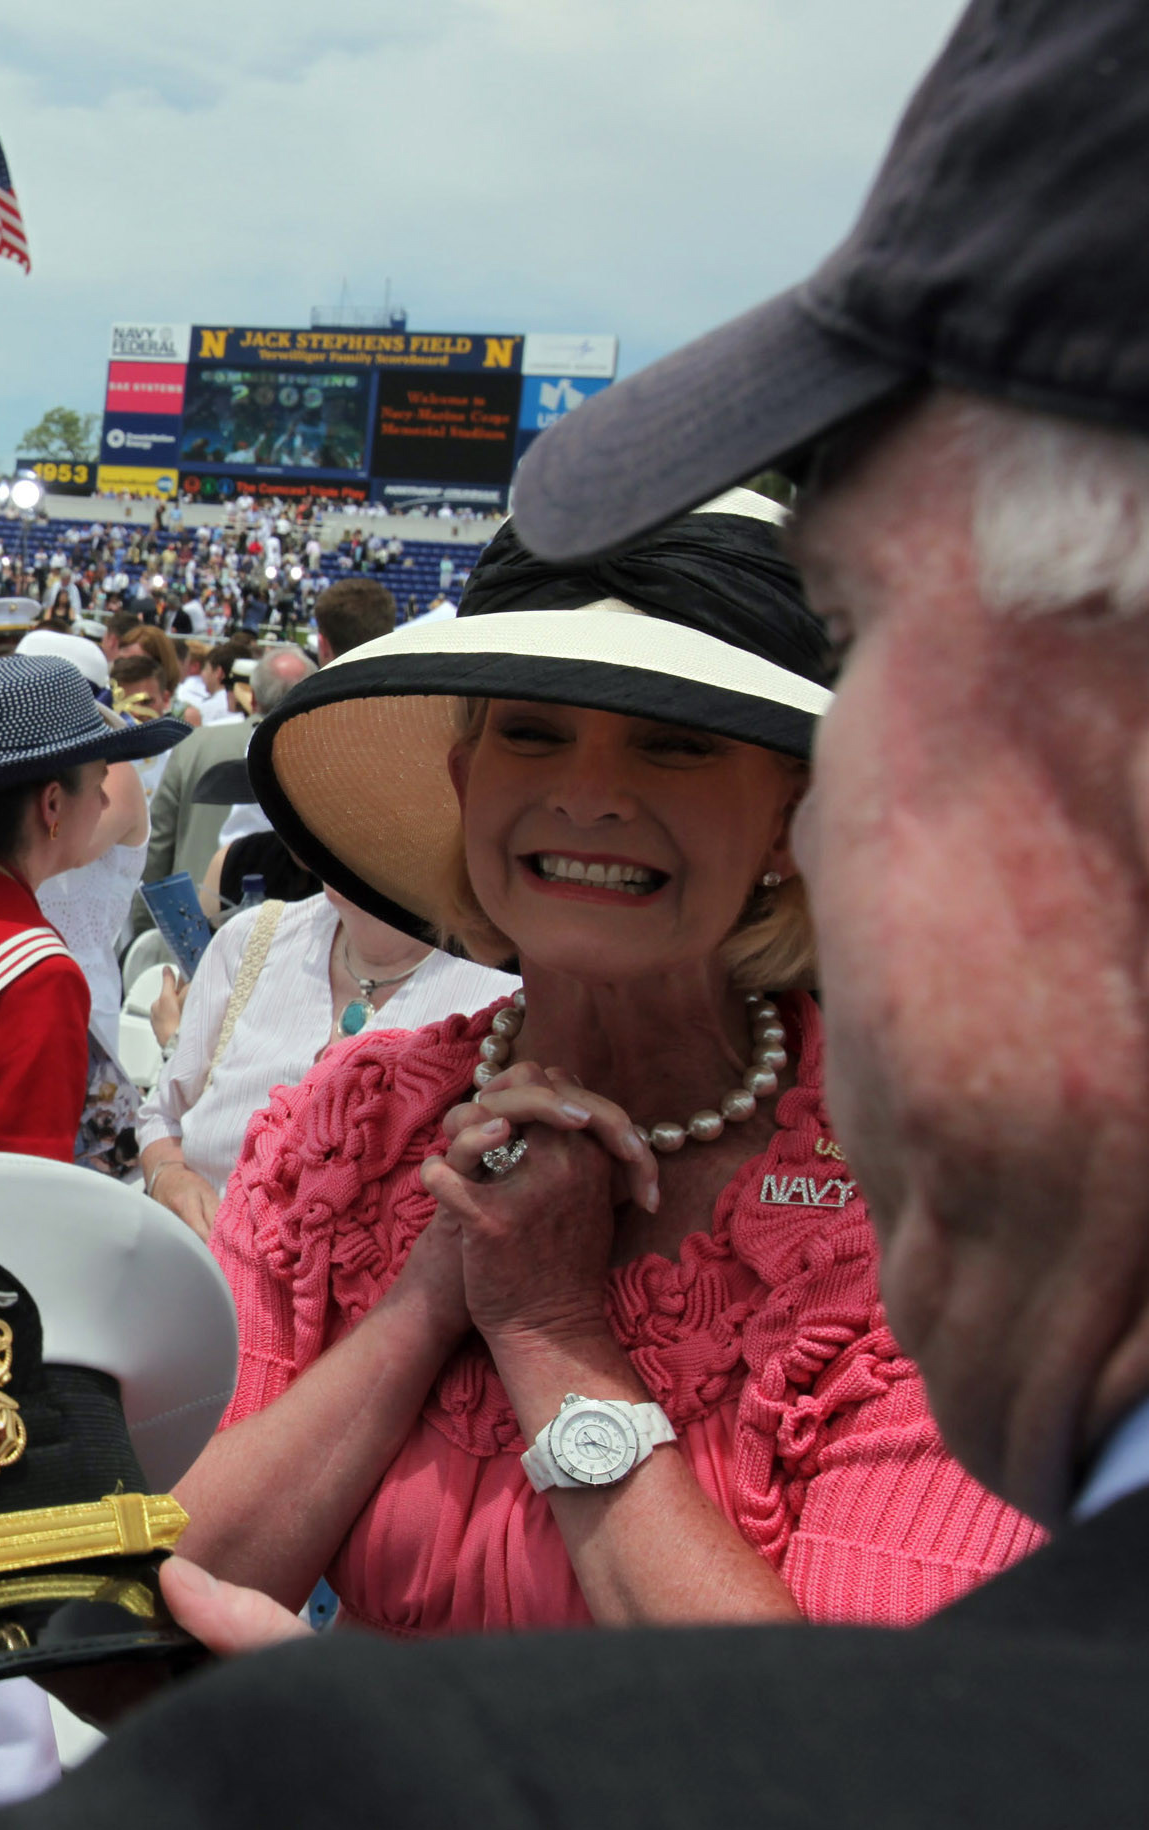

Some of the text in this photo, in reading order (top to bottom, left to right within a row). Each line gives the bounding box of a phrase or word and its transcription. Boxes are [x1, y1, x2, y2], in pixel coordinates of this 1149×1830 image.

[113, 326, 155, 340] NAVY
[239, 331, 472, 354] JACK STEPHENS FIELD
[112, 340, 175, 354] FEDERAL
[199, 329, 227, 358] N
[482, 338, 514, 368] N
[329, 351, 372, 366] Family
[407, 391, 469, 405] Welcome
[381, 422, 506, 440] Memorial Stadium
[32, 462, 89, 484] 1953
[236, 480, 257, 494] The
[341, 486, 366, 500] Play
[760, 1174, 857, 1207] NAVY
